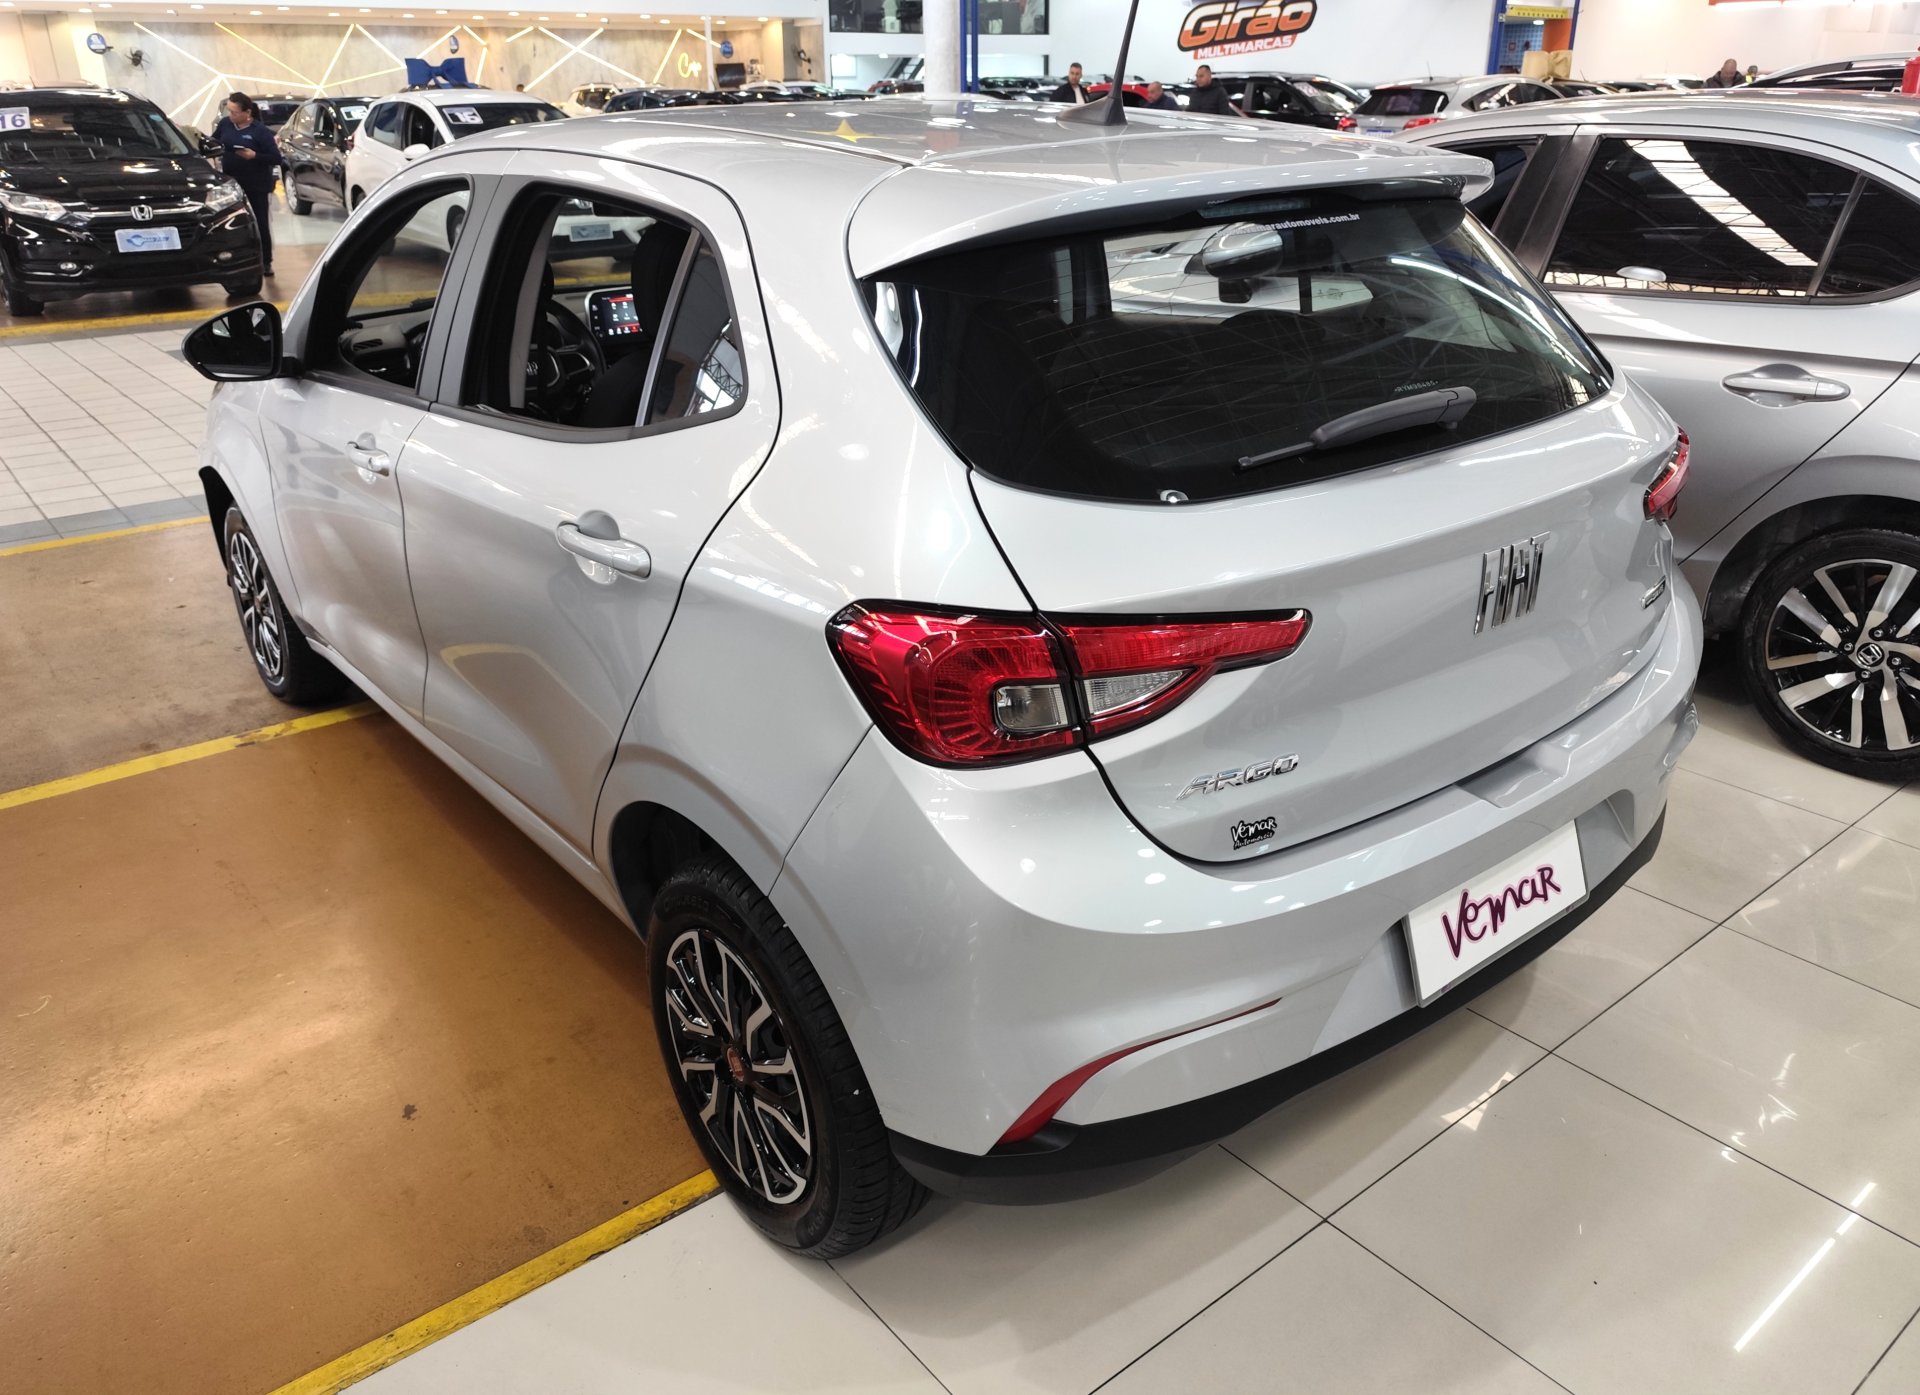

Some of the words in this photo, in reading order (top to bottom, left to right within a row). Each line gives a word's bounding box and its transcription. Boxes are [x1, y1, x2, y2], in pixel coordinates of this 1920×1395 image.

[1198, 35, 1293, 59] MULTIMARCAS
[0, 114, 26, 129] 16
[1473, 531, 1550, 635] FIAT
[1176, 753, 1299, 801] ARGO
